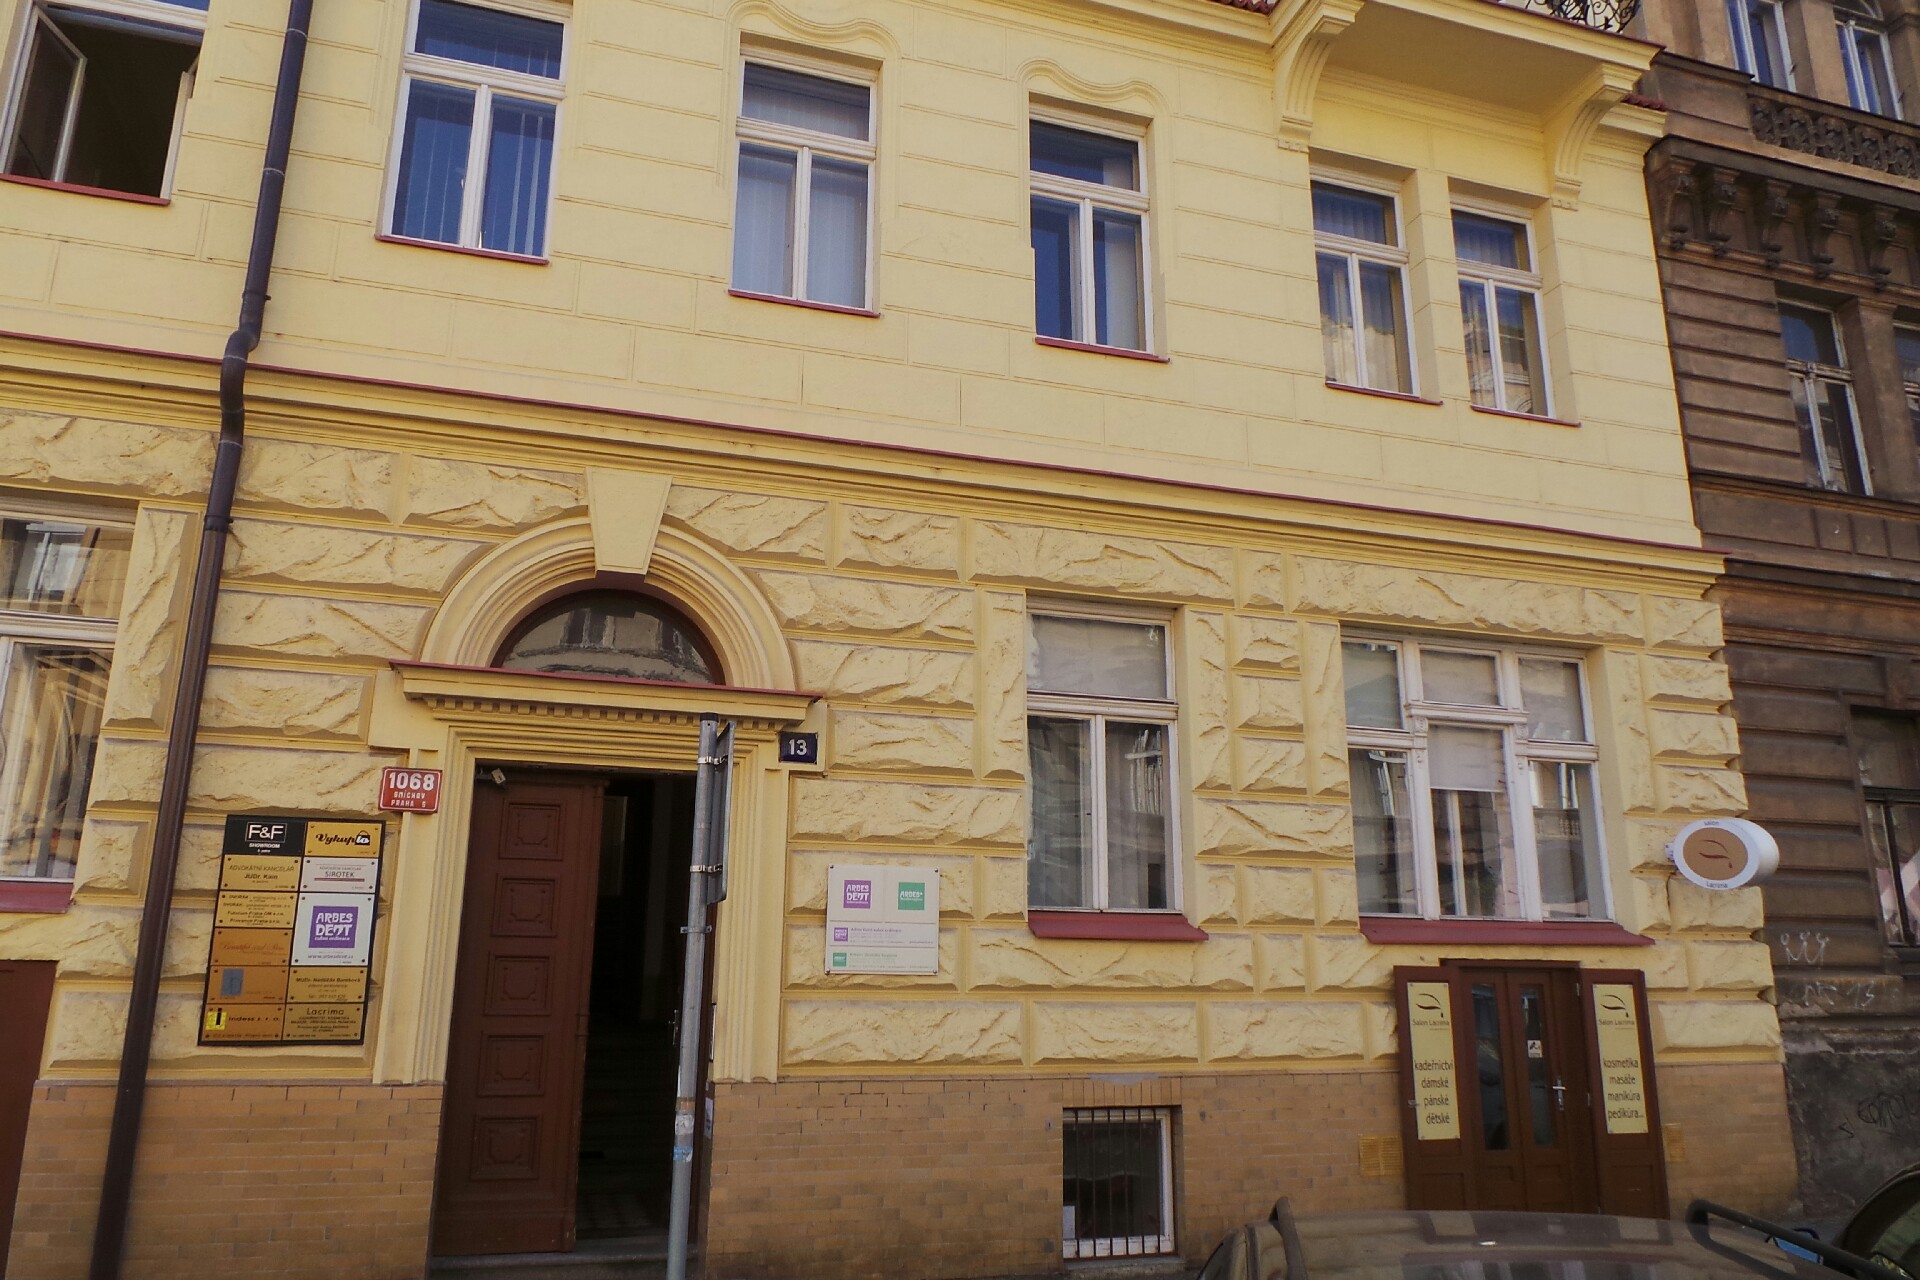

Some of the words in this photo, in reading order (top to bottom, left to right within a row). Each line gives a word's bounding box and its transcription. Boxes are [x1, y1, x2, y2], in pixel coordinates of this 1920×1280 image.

[788, 738, 808, 756] 13
[389, 771, 435, 791] 1068
[390, 799, 414, 807] PRAHA
[248, 824, 284, 840] F&F
[315, 912, 353, 924] ARBES
[306, 1008, 345, 1016] Lacrima
[1414, 1059, 1454, 1071] kadeřnictví
[1603, 1057, 1639, 1068] kosmetika
[1421, 1076, 1449, 1089] dámské
[1609, 1074, 1636, 1085] masáže
[1423, 1094, 1449, 1109] pánské
[1608, 1090, 1641, 1101] manikúra
[1426, 1111, 1450, 1125] dětské
